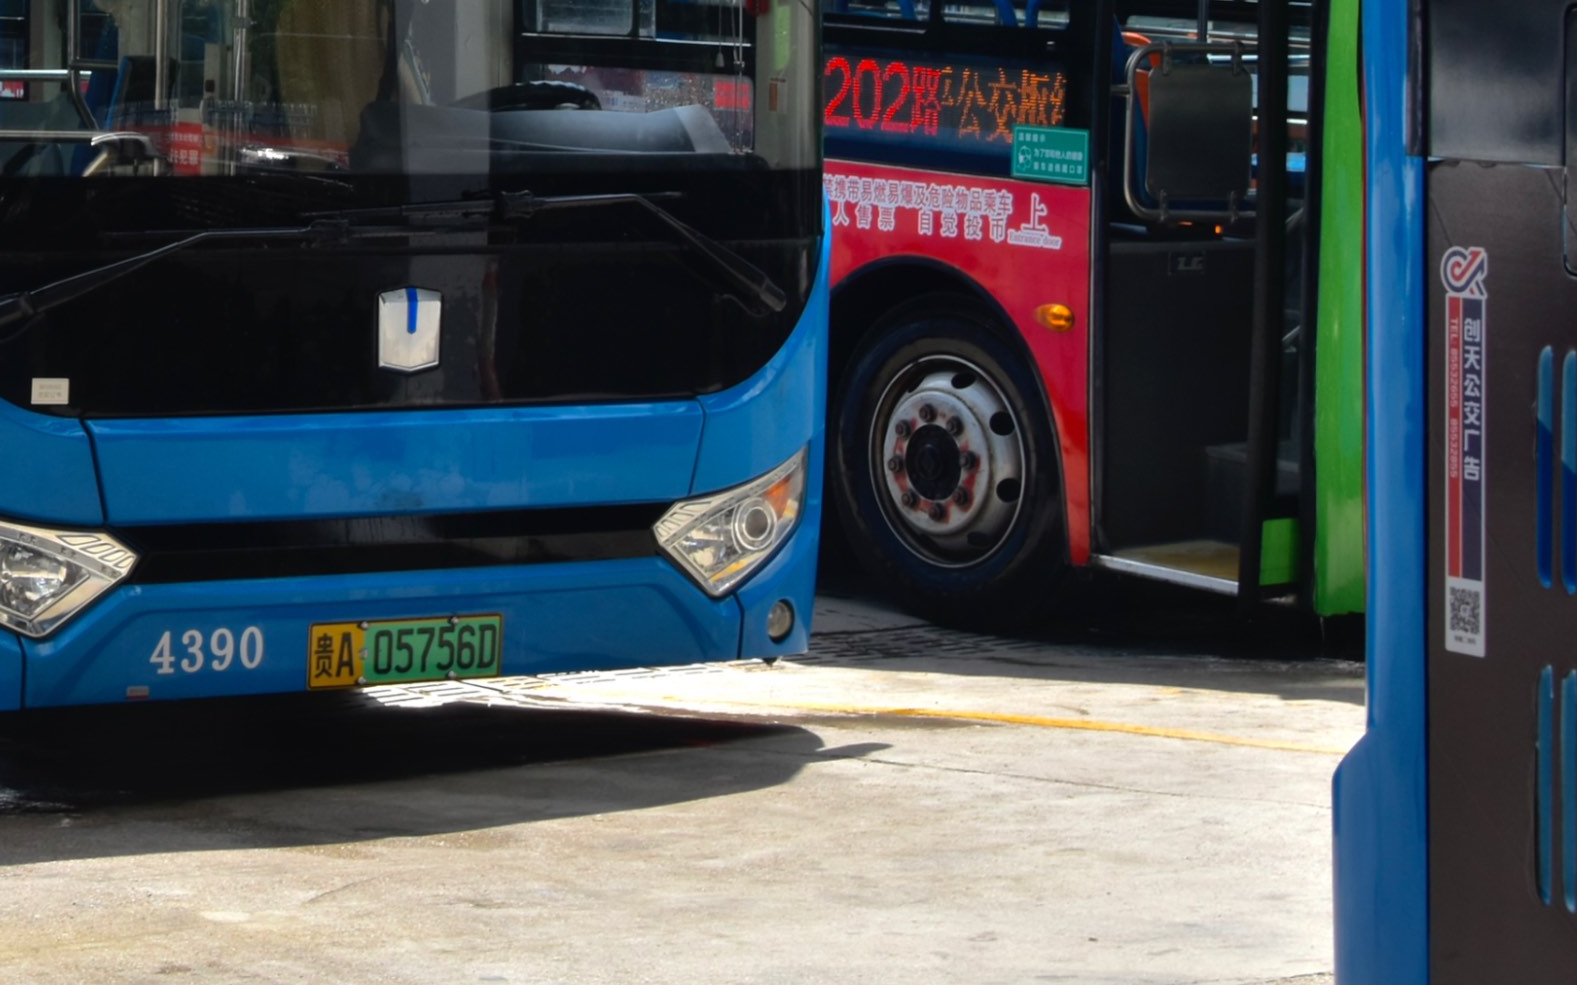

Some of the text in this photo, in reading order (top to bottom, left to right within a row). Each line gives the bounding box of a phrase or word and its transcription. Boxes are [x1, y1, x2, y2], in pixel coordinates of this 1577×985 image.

[1020, 193, 1049, 233] 上
[1463, 317, 1482, 482] 创天公交广告
[148, 625, 265, 675] 4390
[313, 624, 498, 678] 贵A 05756D
